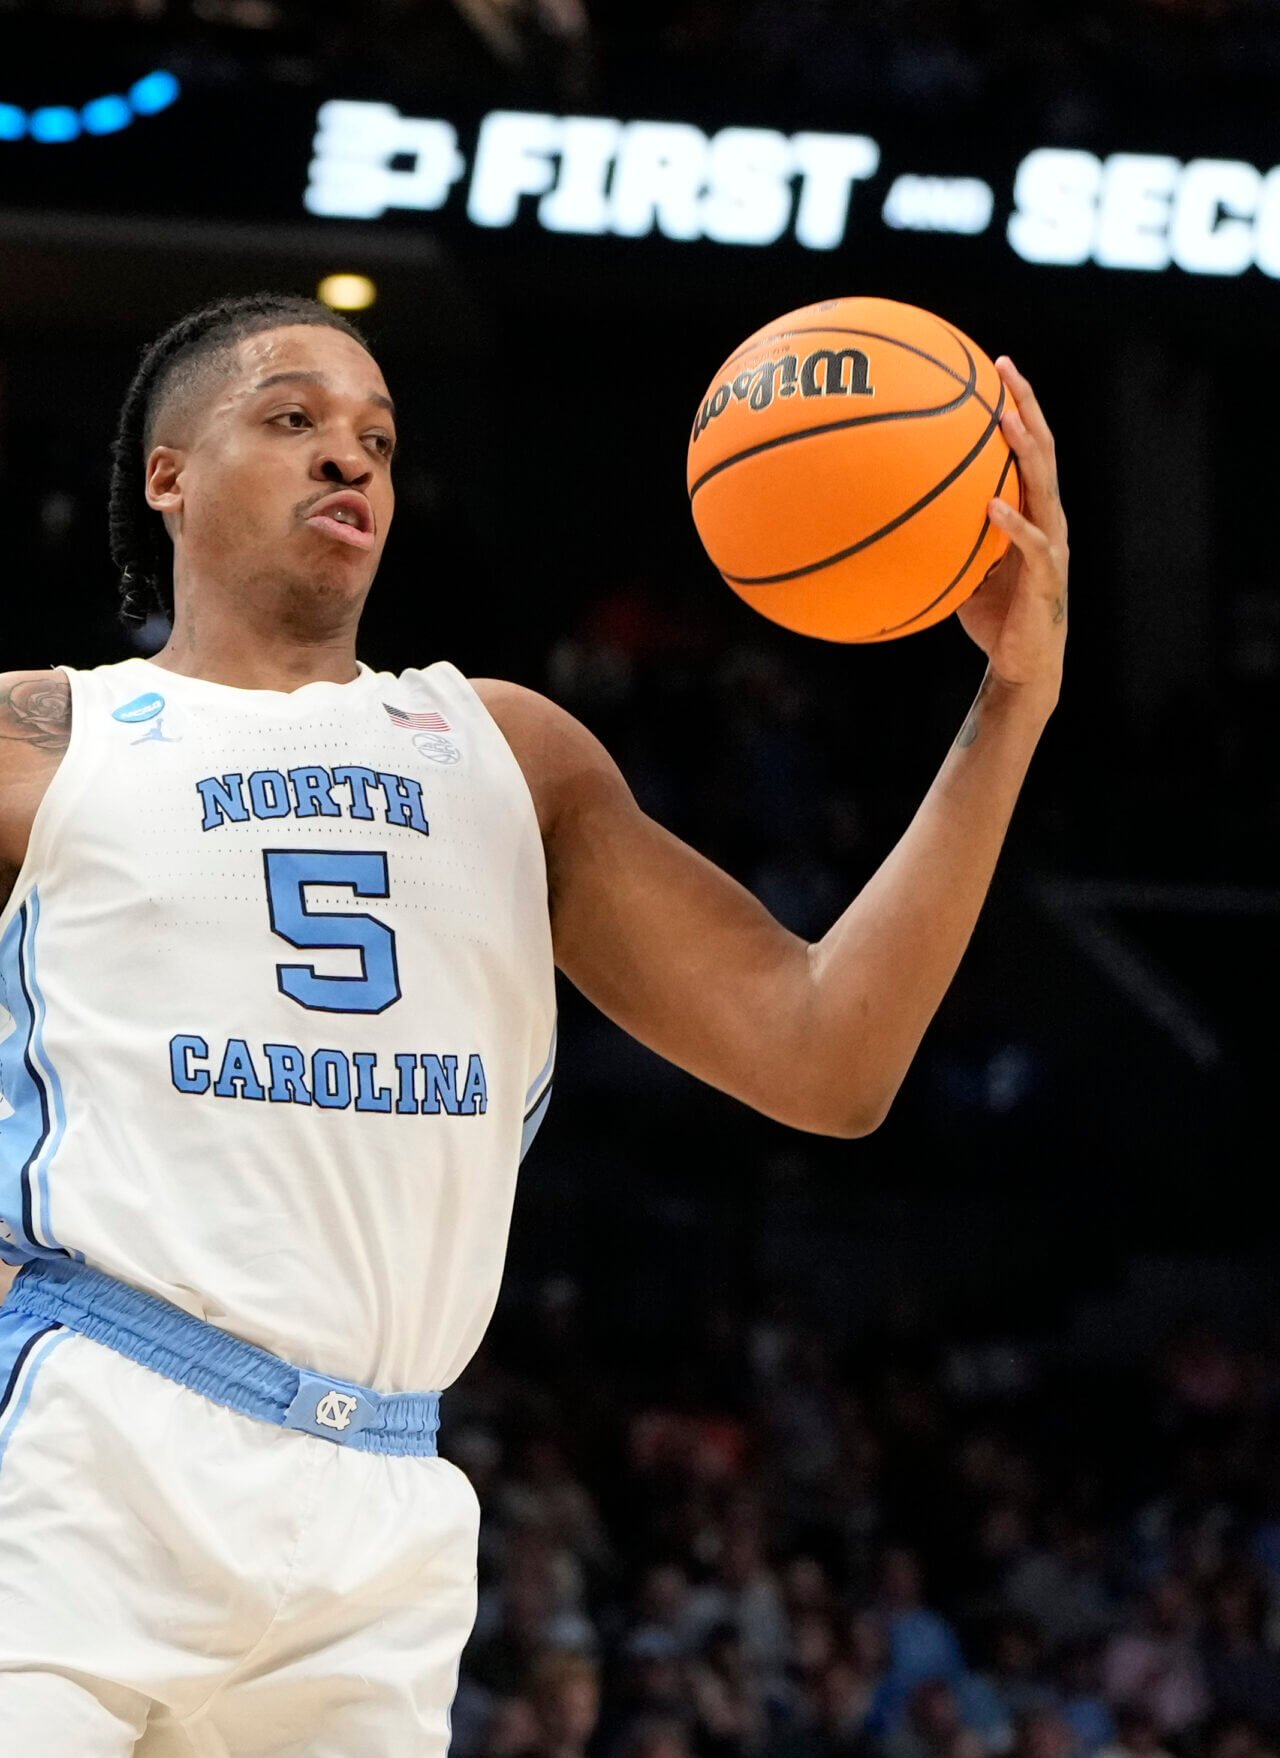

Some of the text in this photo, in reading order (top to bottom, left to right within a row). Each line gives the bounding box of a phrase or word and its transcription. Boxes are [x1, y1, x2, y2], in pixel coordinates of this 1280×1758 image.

[467, 110, 880, 250] FIRST
[693, 348, 876, 442] Wilson
[195, 765, 430, 836] NORTH
[262, 848, 402, 1015] 5
[169, 1034, 488, 1115] CAROLINA
